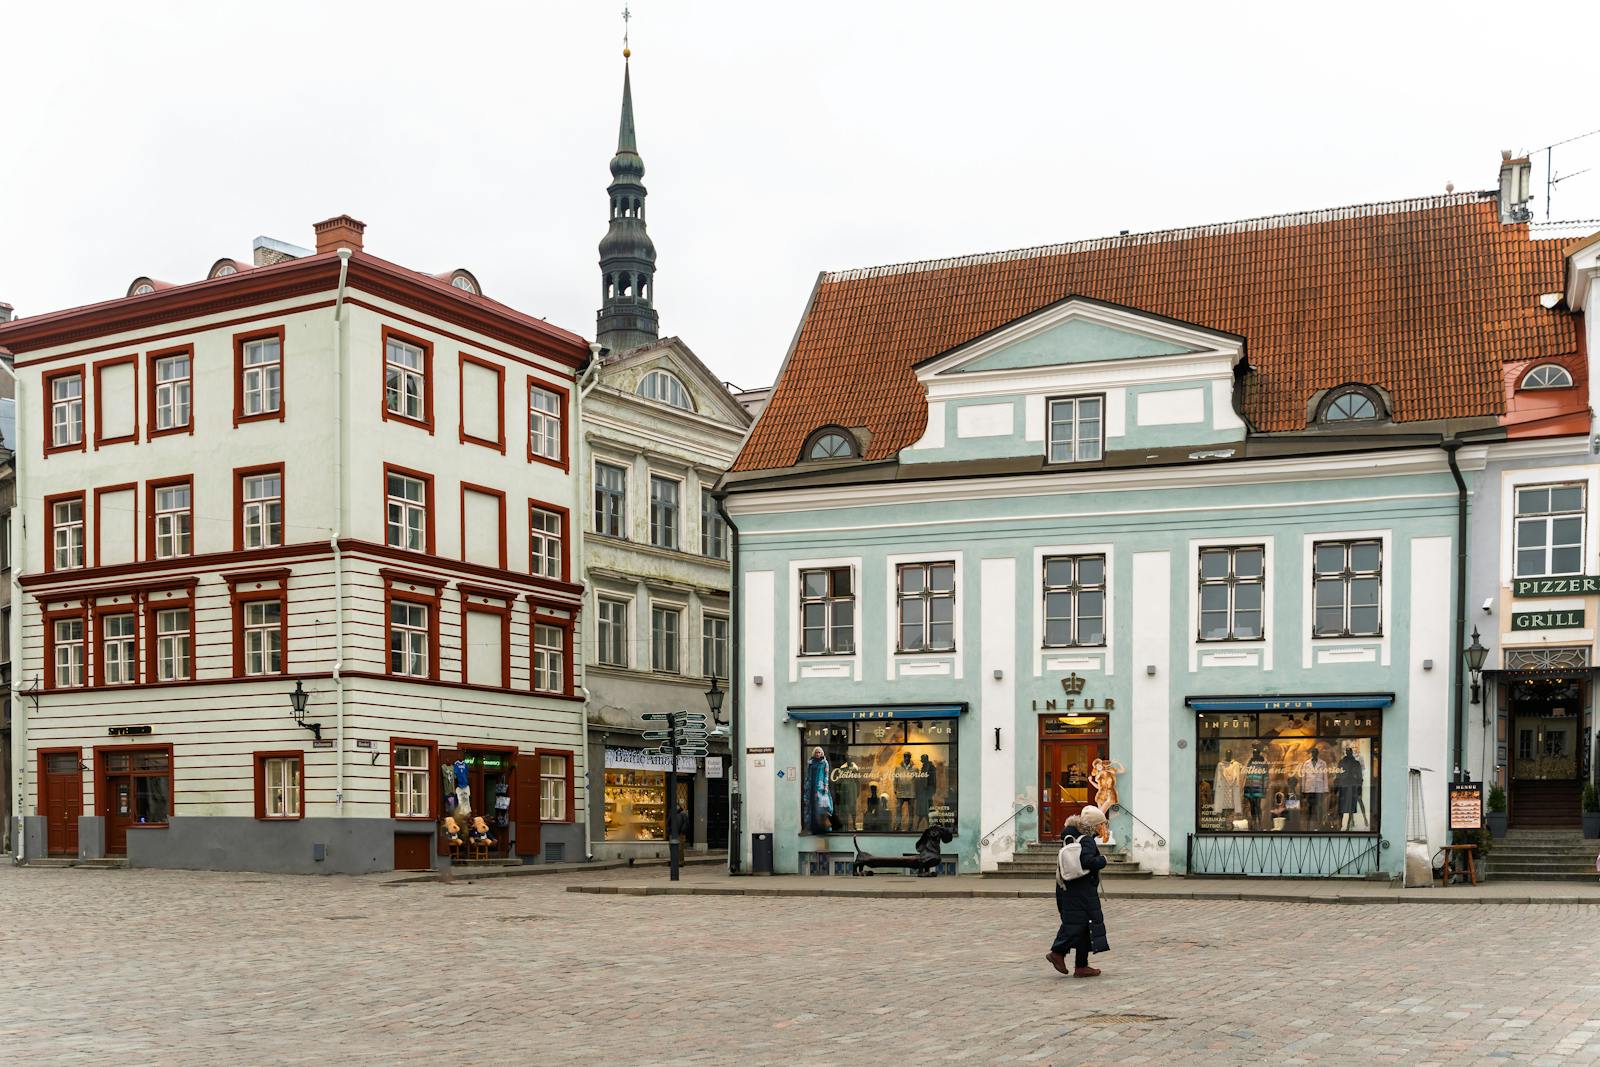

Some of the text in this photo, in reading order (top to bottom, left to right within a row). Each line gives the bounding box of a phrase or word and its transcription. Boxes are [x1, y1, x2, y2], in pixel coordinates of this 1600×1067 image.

[1519, 579, 1600, 594] PIZZER
[1516, 612, 1579, 628] GRILL
[1032, 698, 1115, 712] INFUR
[1205, 721, 1249, 729] INFUR
[1325, 719, 1372, 727] INFUR
[808, 729, 848, 737] INFUR
[830, 767, 862, 782] Clothes
